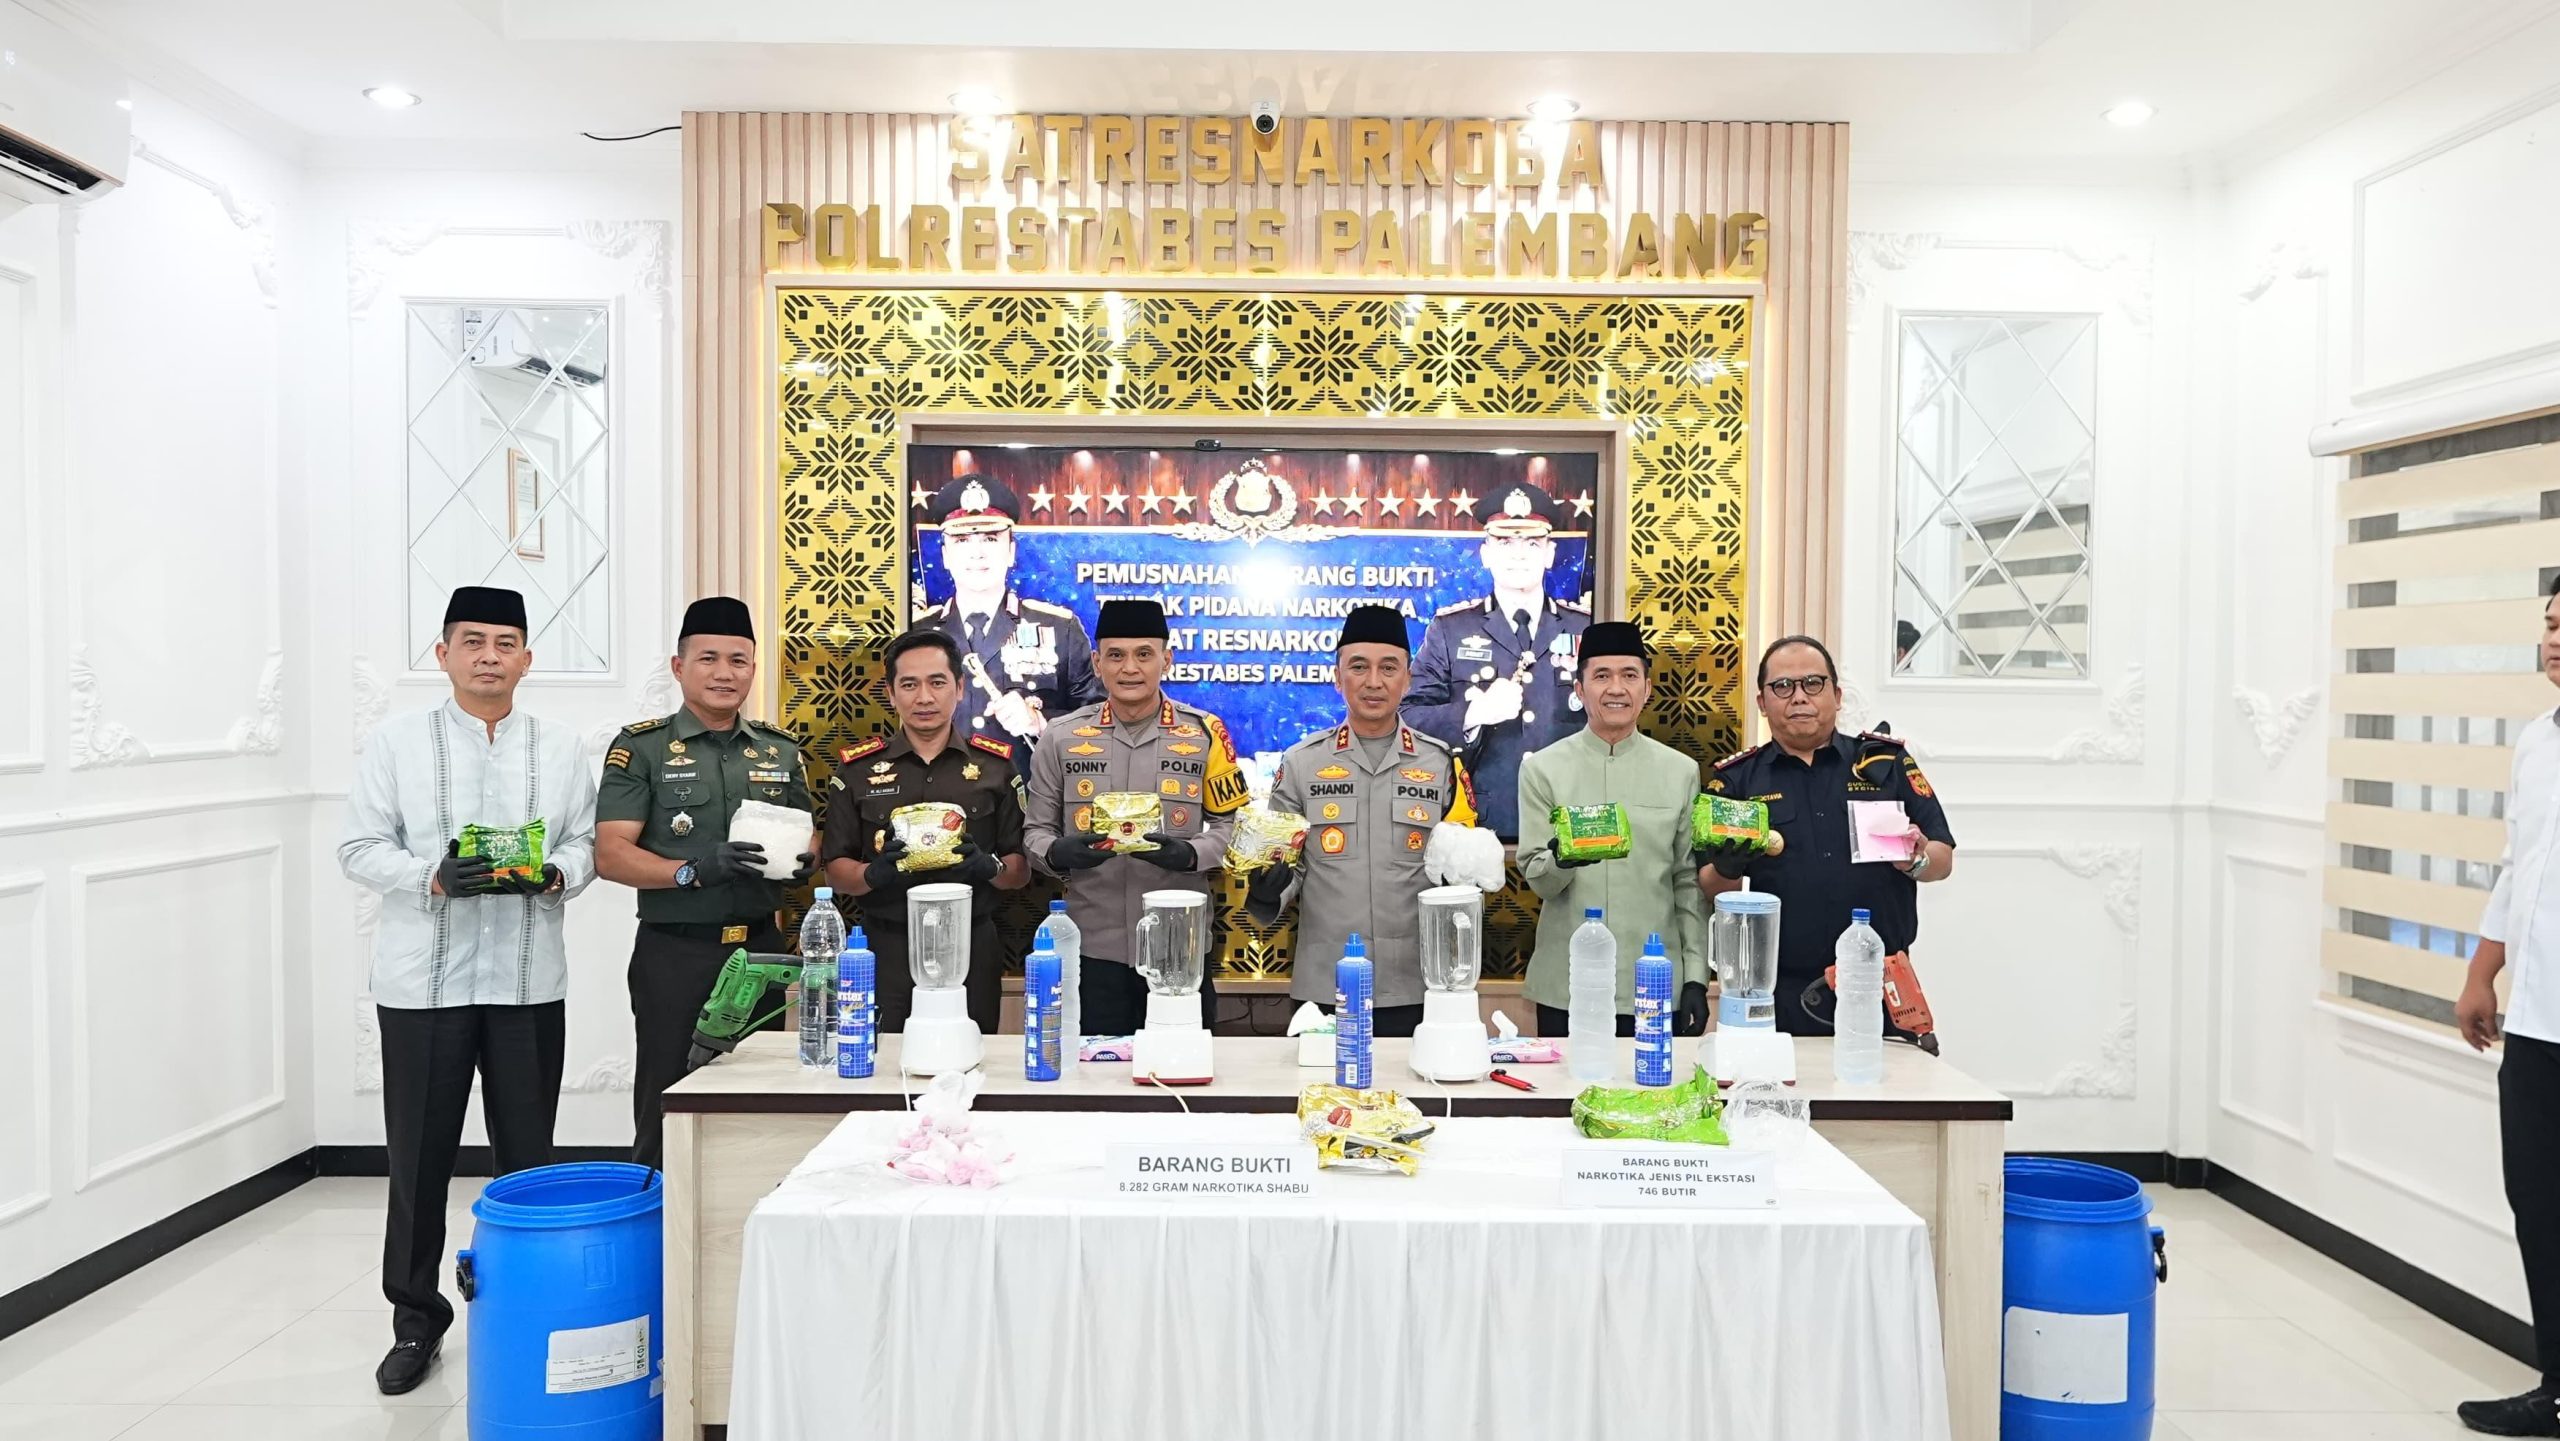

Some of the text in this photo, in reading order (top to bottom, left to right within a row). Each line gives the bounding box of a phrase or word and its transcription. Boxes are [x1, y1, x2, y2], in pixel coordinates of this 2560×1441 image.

[950, 115, 1604, 188] SATRESNARKOBA
[762, 203, 1771, 280] POLRESTABES PALEMBANG
[1362, 566, 1435, 587] BUKTI
[1189, 595, 1276, 617] PIDANA
[1166, 629, 1342, 653] AT RESNARKO
[1161, 663, 1337, 684] RESTABES PALEM
[1065, 760, 1108, 775] SONNY
[1160, 760, 1203, 776] POLRI
[1215, 776, 1237, 803] KA
[1310, 783, 1354, 797] SHANDI
[1397, 785, 1439, 801] POLRI
[1138, 1156, 1291, 1173] BARANG BUKTI
[1622, 1157, 1709, 1168] BARANG BUKTI
[1577, 1171, 1755, 1183] NARKOTIKA JENIS PIL EKSTASI
[1119, 1182, 1309, 1193] 8.282 GRAM NARKOTIKA SHABU
[1638, 1186, 1697, 1197] 746 BUTIR
